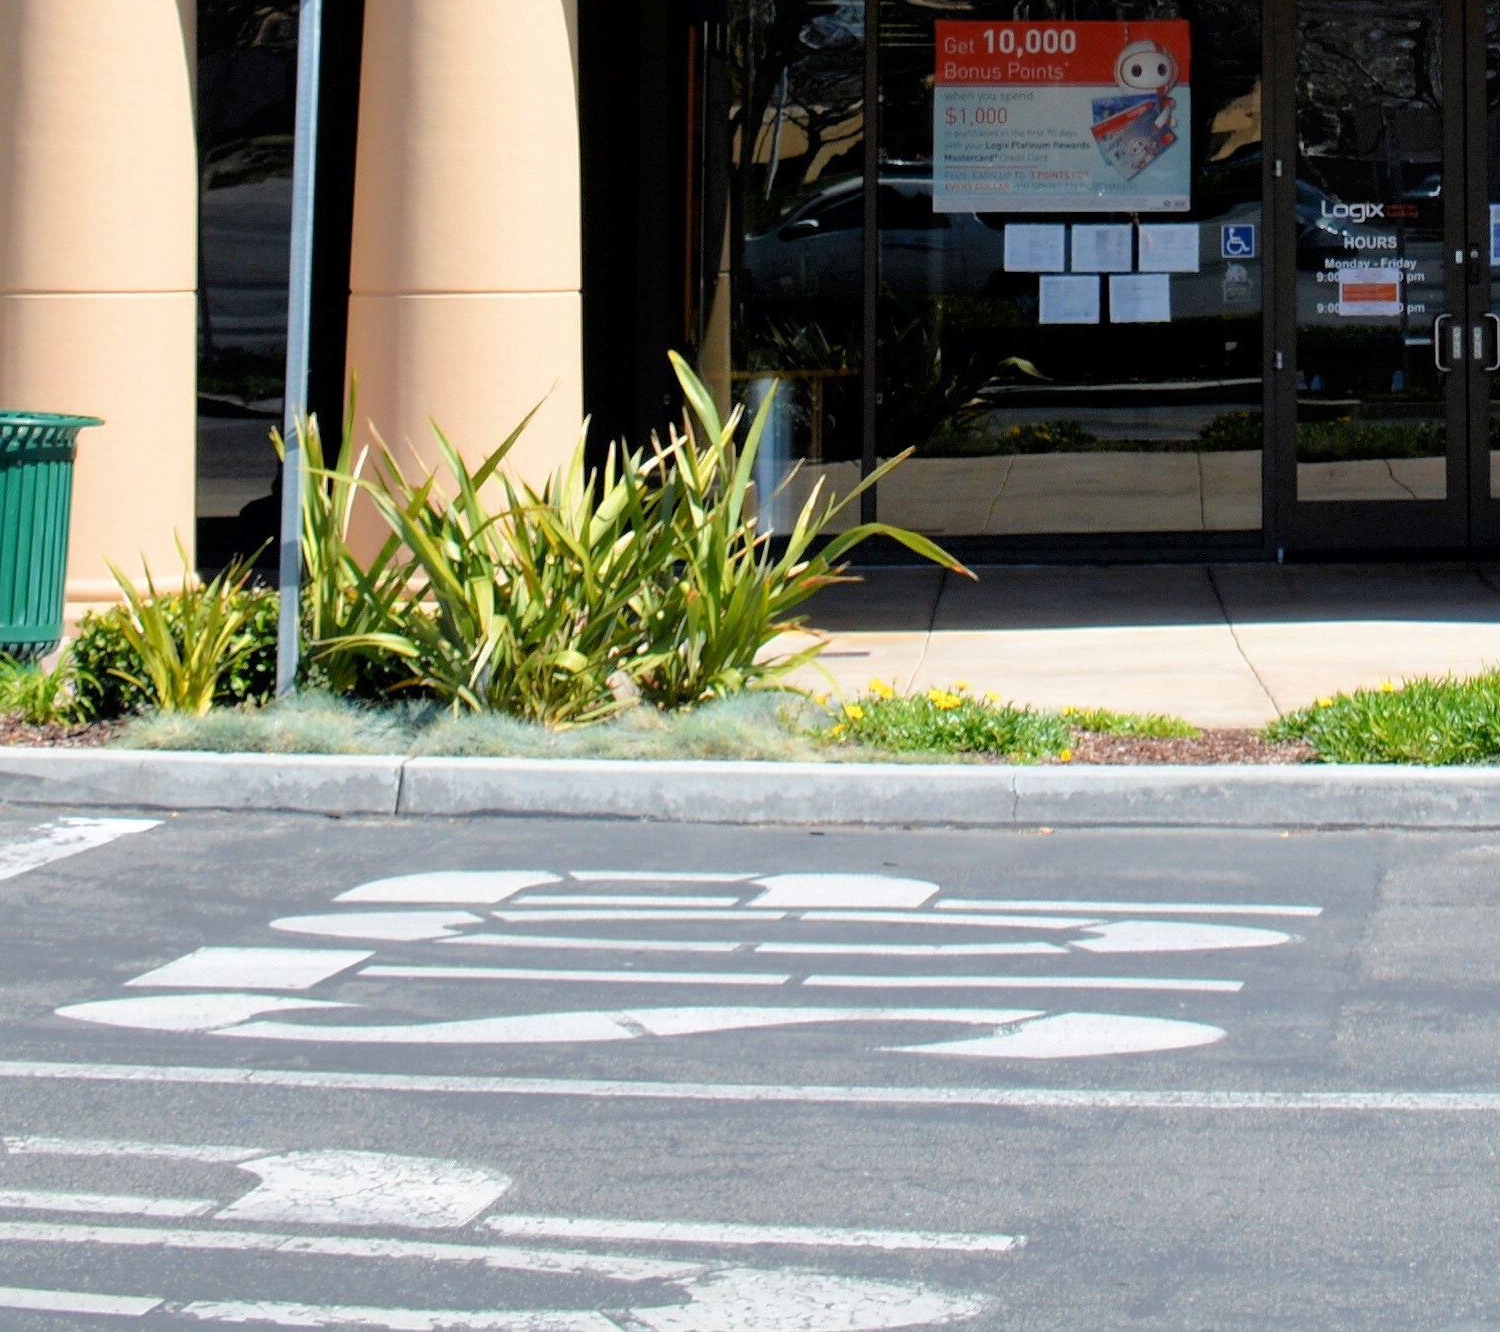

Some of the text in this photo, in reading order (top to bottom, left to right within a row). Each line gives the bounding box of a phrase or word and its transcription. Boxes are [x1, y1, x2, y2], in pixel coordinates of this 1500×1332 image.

[943, 28, 1077, 58] Get 10,000
[944, 61, 1002, 80] Bonus
[945, 106, 1008, 126] $1,000
[1320, 200, 1385, 223] Logix
[1343, 236, 1398, 250] HOURS
[1324, 258, 1370, 270] Monday
[1380, 257, 1417, 270] Friday
[1405, 272, 1426, 283] pm
[1406, 304, 1426, 315] pm
